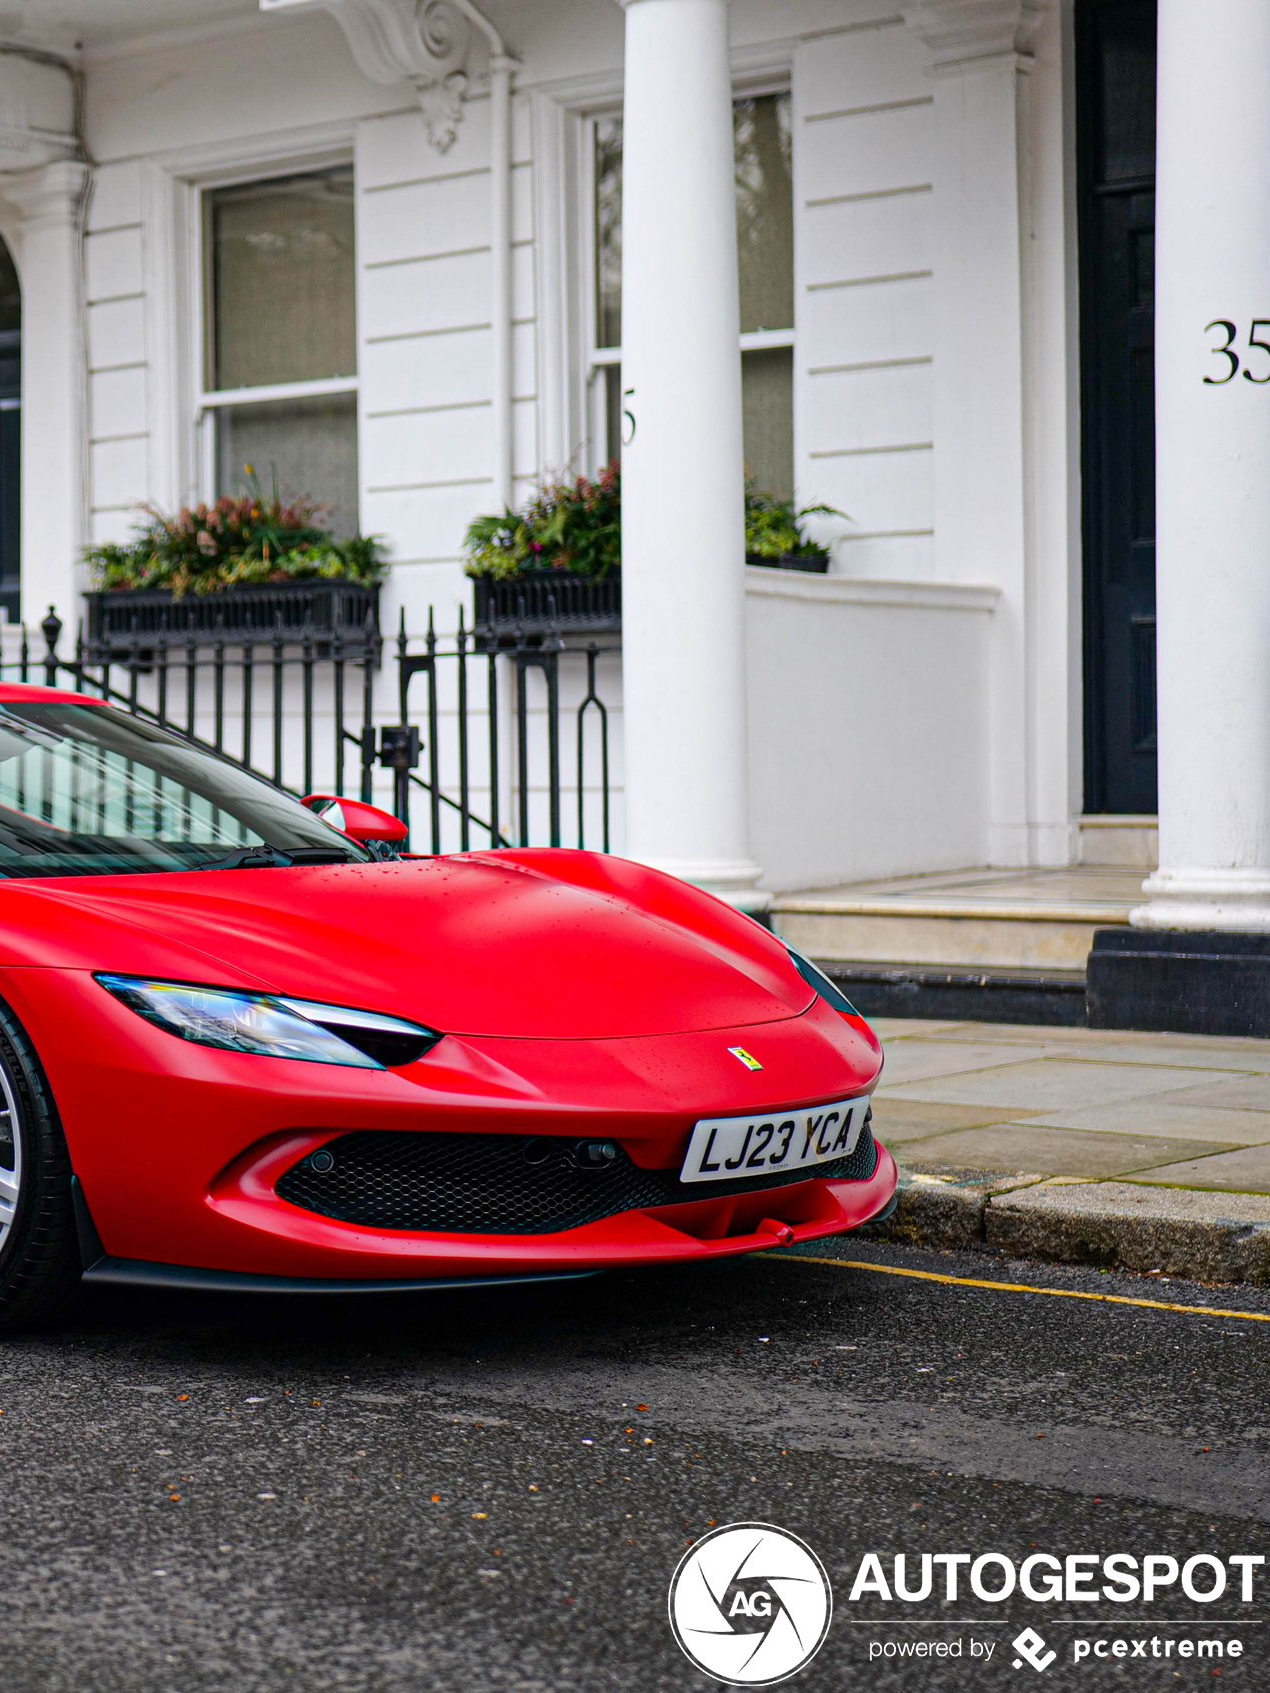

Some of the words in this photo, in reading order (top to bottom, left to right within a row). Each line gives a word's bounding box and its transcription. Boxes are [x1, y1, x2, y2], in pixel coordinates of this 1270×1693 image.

[1202, 318, 1270, 385] 35
[698, 1120, 796, 1172] LJ23
[801, 1108, 854, 1158] YCA
